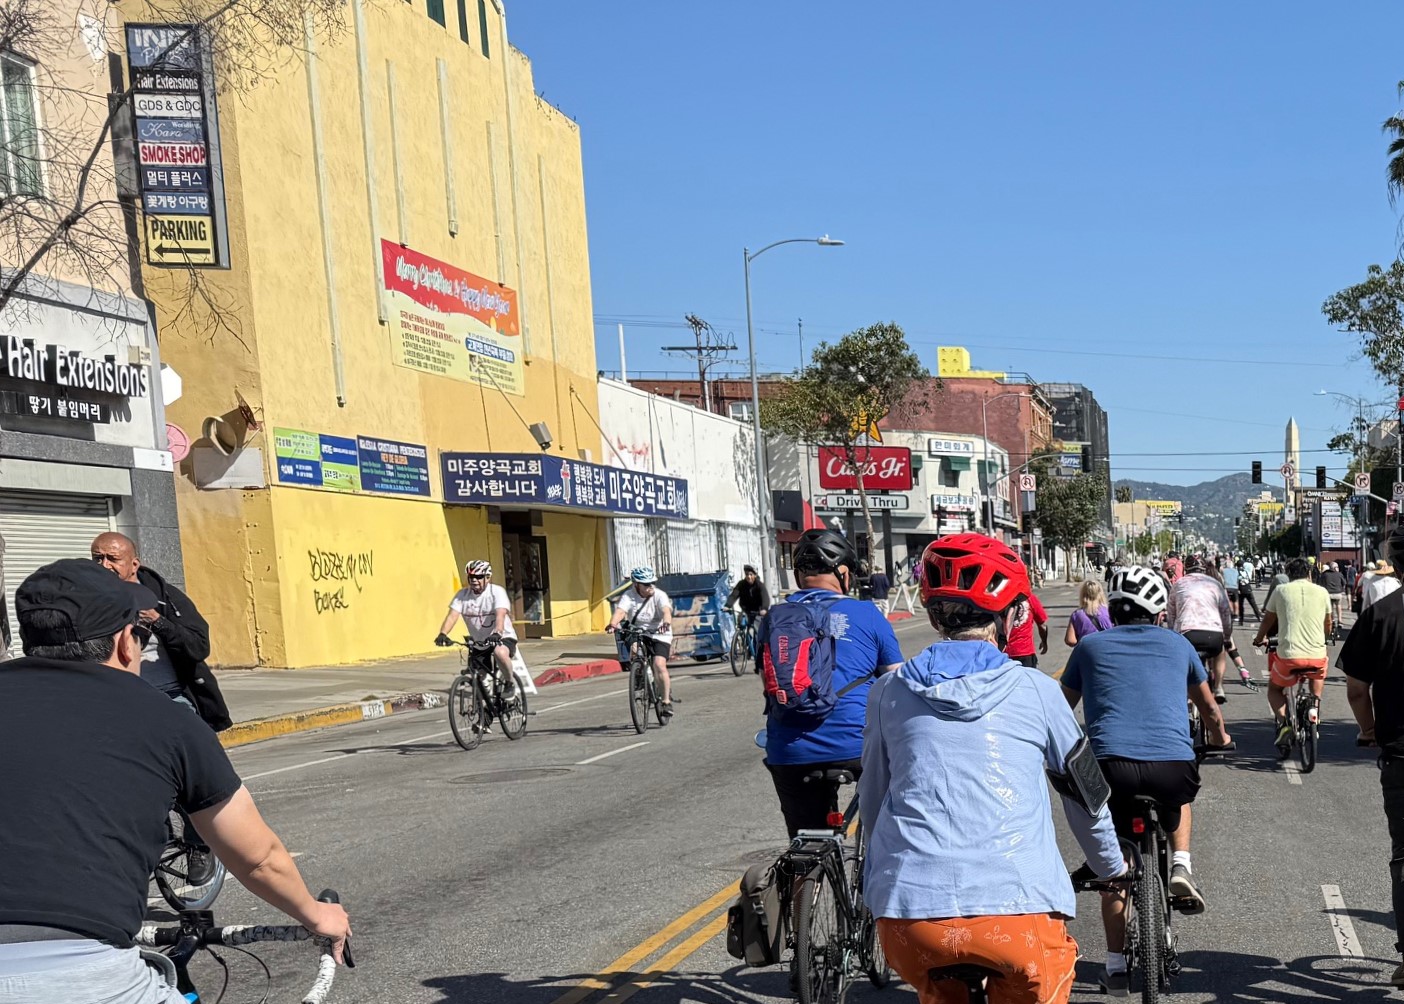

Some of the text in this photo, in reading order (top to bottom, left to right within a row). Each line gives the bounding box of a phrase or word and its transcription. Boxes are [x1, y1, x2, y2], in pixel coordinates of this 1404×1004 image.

[155, 75, 199, 90] Extensions
[138, 100, 201, 111] GDS & GDC
[141, 122, 183, 138] Kara
[141, 145, 206, 164] SMOKE SHOP
[146, 170, 202, 187] 멀티 플러스
[151, 220, 207, 241] PARKING
[7, 335, 148, 398] Hair Extensions
[29, 395, 101, 421] 땋기 붙임머리
[447, 459, 542, 476] 미주양곡교회
[879, 457, 905, 478] Jr.
[454, 479, 537, 497] 감사합니다
[609, 471, 678, 513] 미주양곡교회
[836, 496, 864, 508] Driv
[872, 496, 899, 508] Thru
